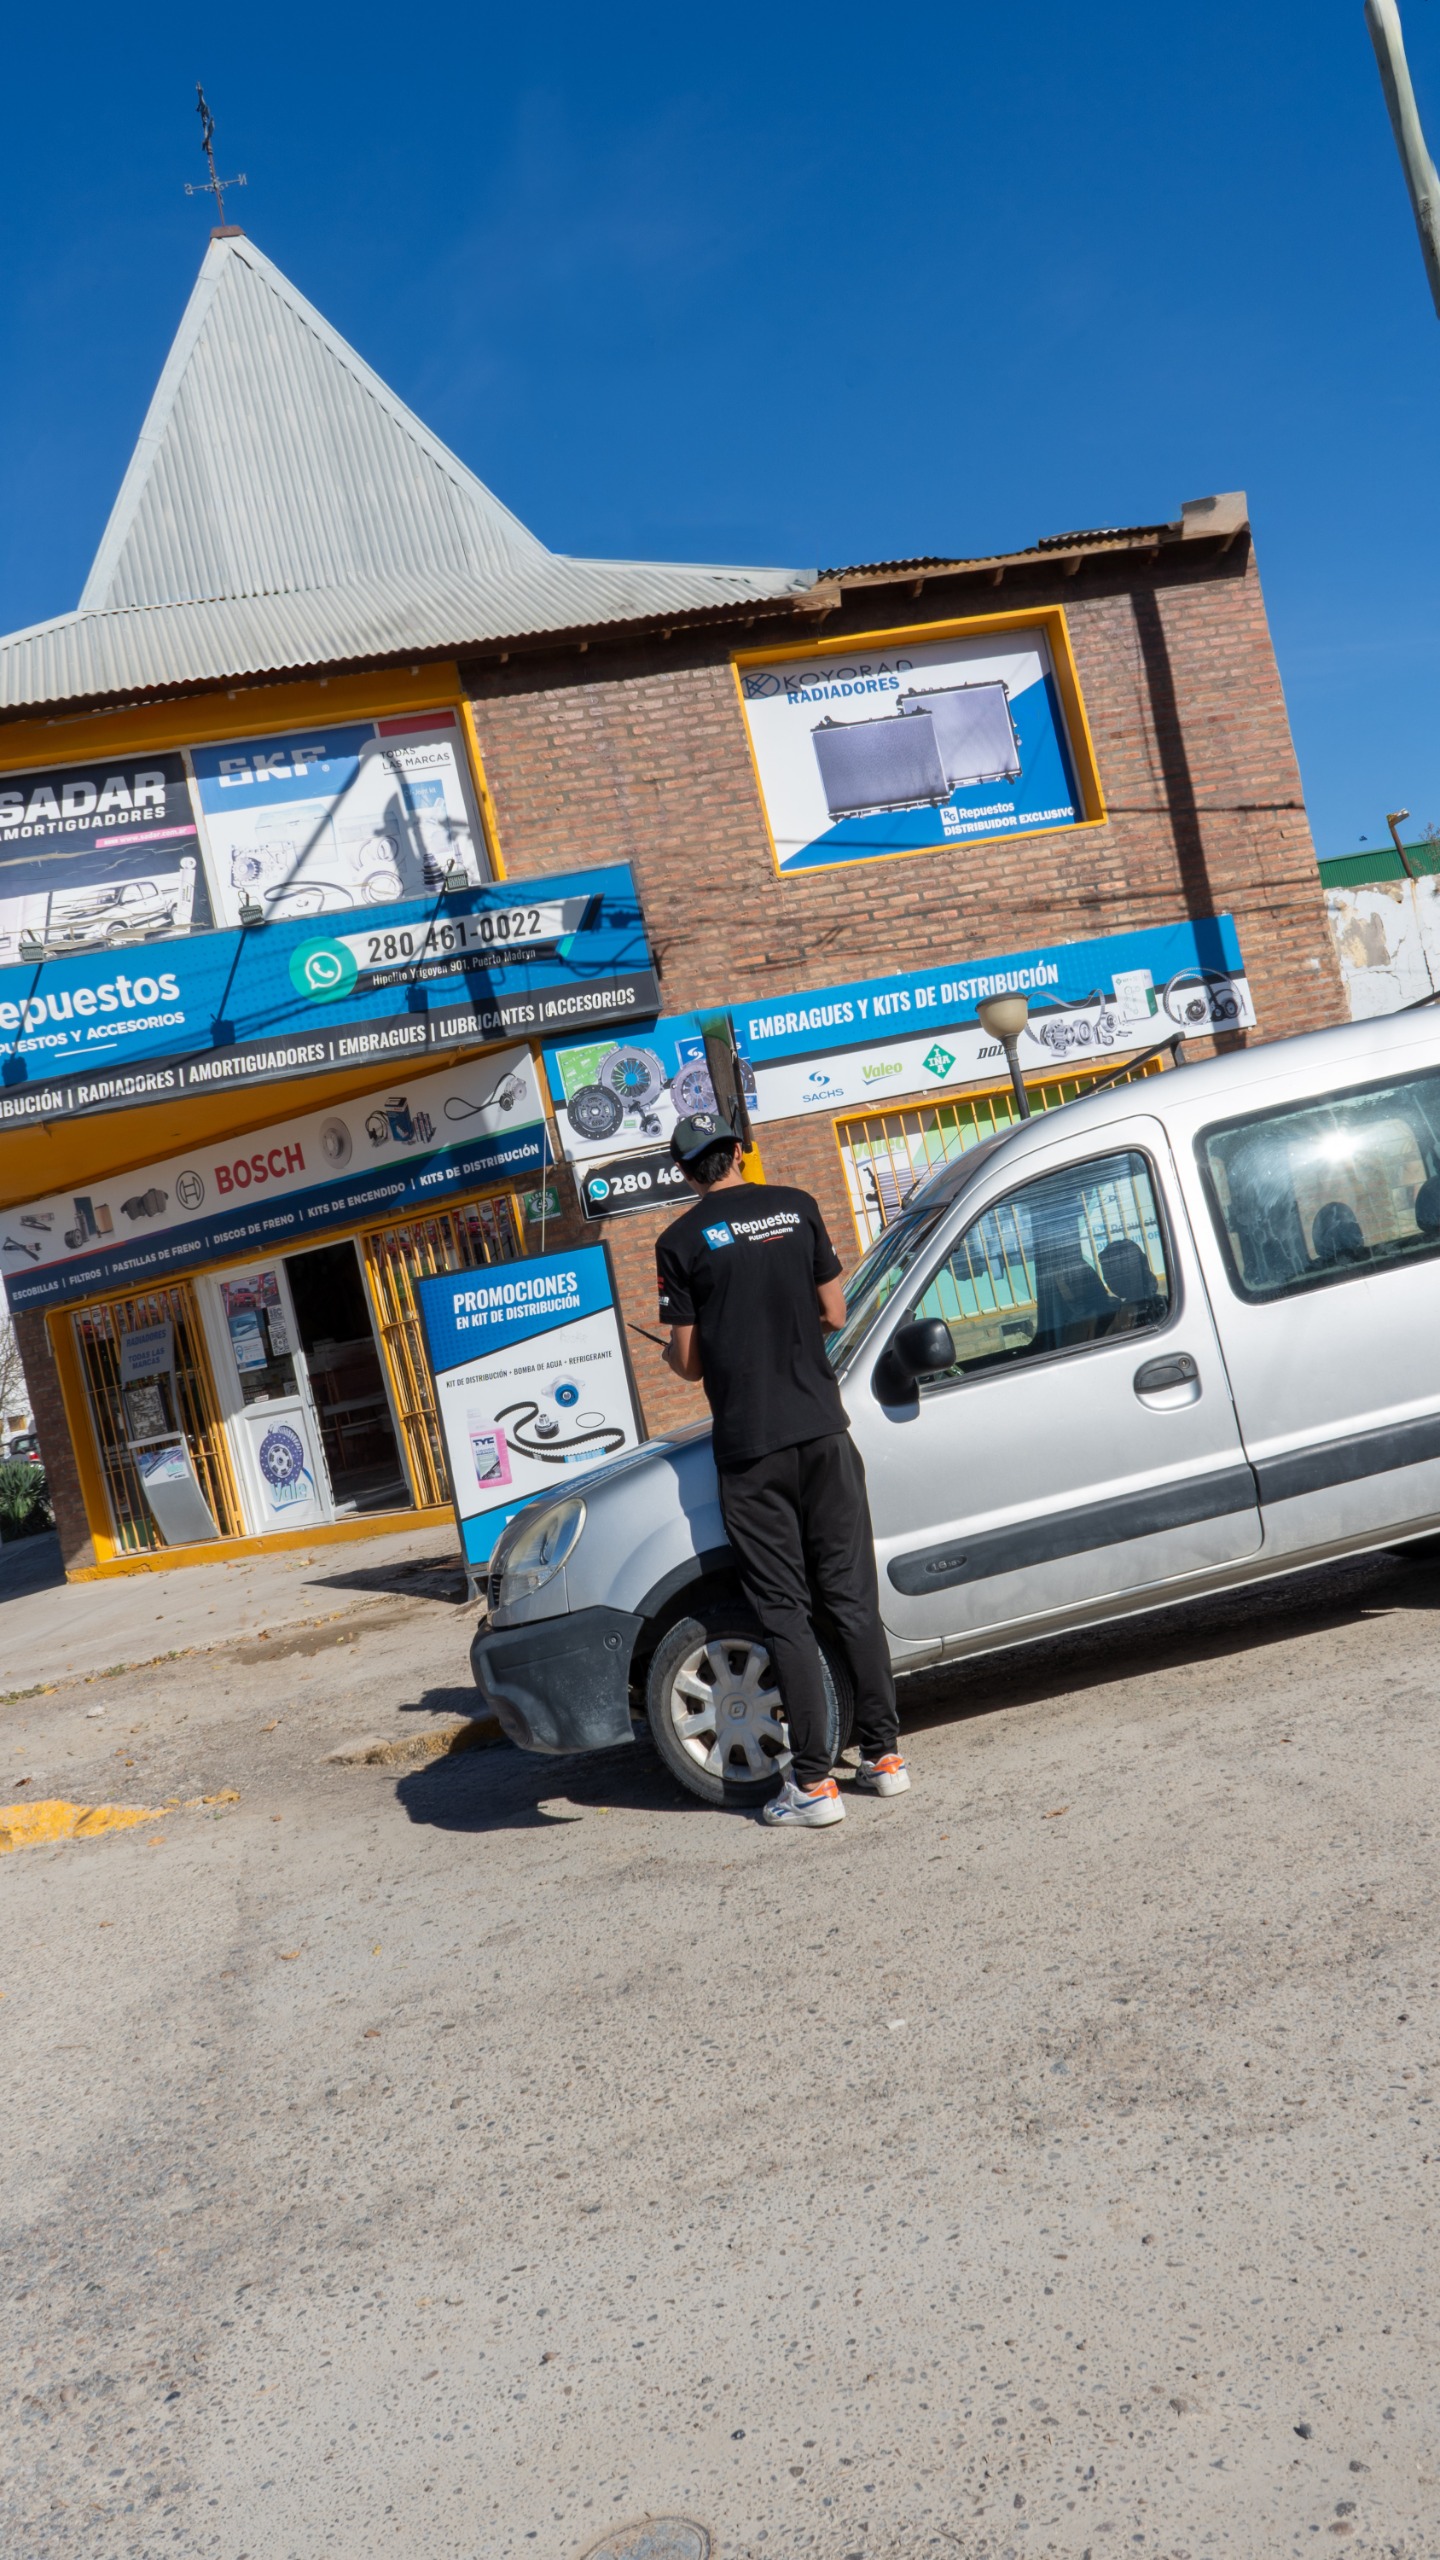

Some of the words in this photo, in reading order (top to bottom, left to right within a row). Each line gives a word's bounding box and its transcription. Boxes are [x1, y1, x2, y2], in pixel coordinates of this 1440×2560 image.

[783, 659, 913, 689] KOYORAD
[786, 676, 900, 705] RADIADORES
[218, 746, 326, 788] SKF
[380, 747, 416, 760] TODAS
[382, 760, 403, 770] LAS
[405, 752, 450, 767] MARCAS
[0, 771, 166, 827] SADAR
[959, 802, 1015, 820] Repuestos
[0, 806, 166, 842] MORTIGUADORES
[943, 816, 1017, 836] DISTRIBUIDOR
[1018, 807, 1075, 824] EXCLUSIVO
[368, 931, 414, 963] 280
[425, 910, 542, 951] 461-0022
[409, 965, 448, 981] Yrigoyen
[472, 954, 501, 968] Puerto
[504, 949, 536, 963] Madryn
[749, 1002, 854, 1040] EMBRAGUES
[856, 999, 869, 1019] Y
[873, 991, 911, 1017] KITS
[915, 986, 937, 1009] DE
[941, 961, 1059, 1004] DISTRIBUCIÓN
[70, 1029, 83, 1043] Y
[87, 1011, 185, 1041] ACCESORIOS
[78, 1070, 175, 1104] RADIADORES
[189, 1043, 325, 1083] AMORTIGUADORES
[338, 1024, 427, 1057] EMBRAGUES
[440, 1004, 535, 1038] LUBRICANTES
[549, 987, 636, 1017] ACCESORIOS
[977, 1044, 1006, 1060] DOL
[862, 1061, 903, 1079] Valeo
[802, 1088, 844, 1103] SACHS
[214, 1142, 306, 1195] BOSCH
[610, 1171, 652, 1195] 280
[12, 1281, 59, 1301] ESCOBILLAS
[69, 1268, 101, 1285] FILTROS
[112, 1254, 156, 1272] PASTILLAS
[158, 1248, 170, 1260] DE
[172, 1240, 201, 1257] FRENO
[213, 1227, 247, 1244] DISCOS
[248, 1223, 261, 1236] DE
[263, 1213, 295, 1231] FRENO
[307, 1201, 330, 1218] KITS
[331, 1198, 346, 1211] DE
[348, 1182, 406, 1207] ENCENDIDO
[419, 1171, 444, 1186] KITS
[445, 1167, 461, 1180] DE
[462, 1144, 540, 1174] DISTRIBUCIÓN
[706, 1228, 730, 1242] RG
[731, 1212, 800, 1235] Repuestos
[748, 1231, 770, 1242] PUERTO
[770, 1226, 794, 1236] MADRYN
[453, 1271, 578, 1315] PROMOCIONES
[456, 1316, 469, 1330] EN
[471, 1312, 489, 1327] KIT
[490, 1309, 504, 1324] DE
[506, 1292, 580, 1320] DISTRIBUCIÓN
[126, 1329, 167, 1347] RADIADORES
[127, 1350, 150, 1362] TODAS
[151, 1347, 165, 1357] LAS
[132, 1356, 160, 1369] MARCAS
[446, 1379, 456, 1389] KIT
[456, 1377, 465, 1386] DE
[466, 1368, 508, 1385] DISTRIBUCIÓN
[513, 1365, 536, 1376] BOMBA
[536, 1362, 545, 1371] DE
[546, 1360, 562, 1369] AGUA
[568, 1350, 613, 1366] REFRIGERANTE
